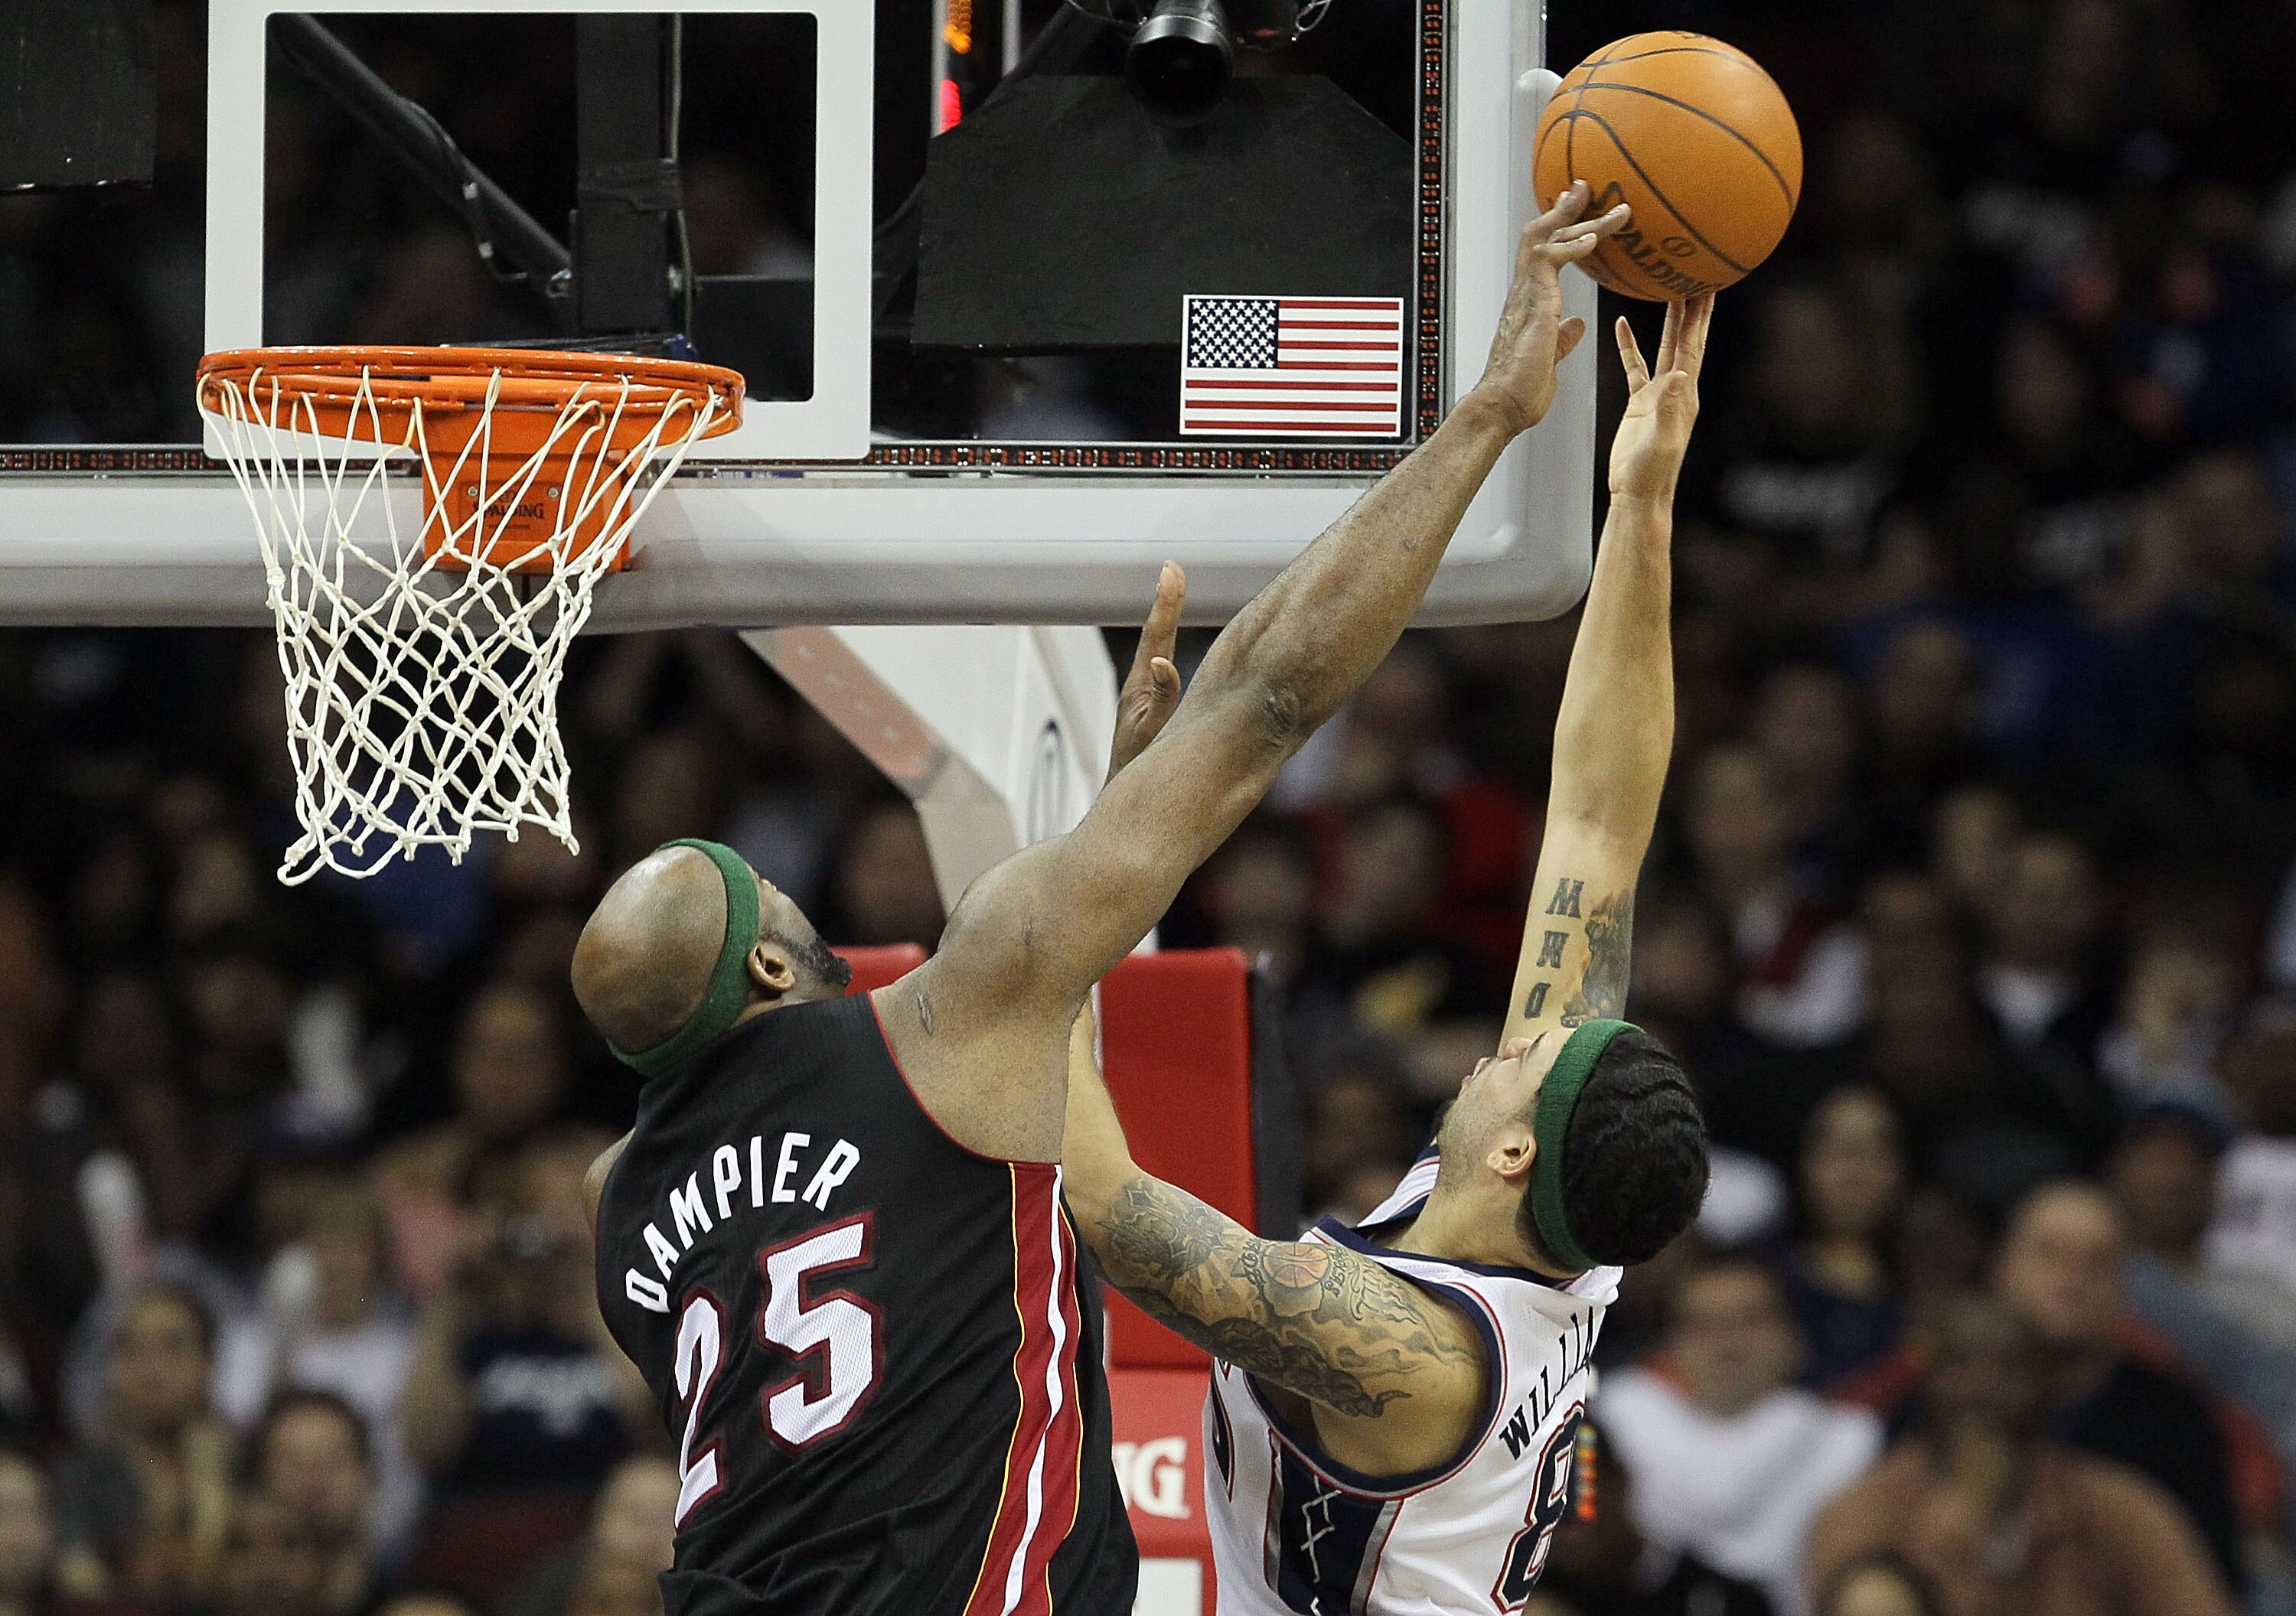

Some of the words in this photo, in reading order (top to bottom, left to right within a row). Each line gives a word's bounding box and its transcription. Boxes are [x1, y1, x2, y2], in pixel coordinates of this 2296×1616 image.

[472, 502, 544, 520] PALING
[626, 1132, 859, 1314] DAMPIER
[673, 1210, 880, 1533] 25
